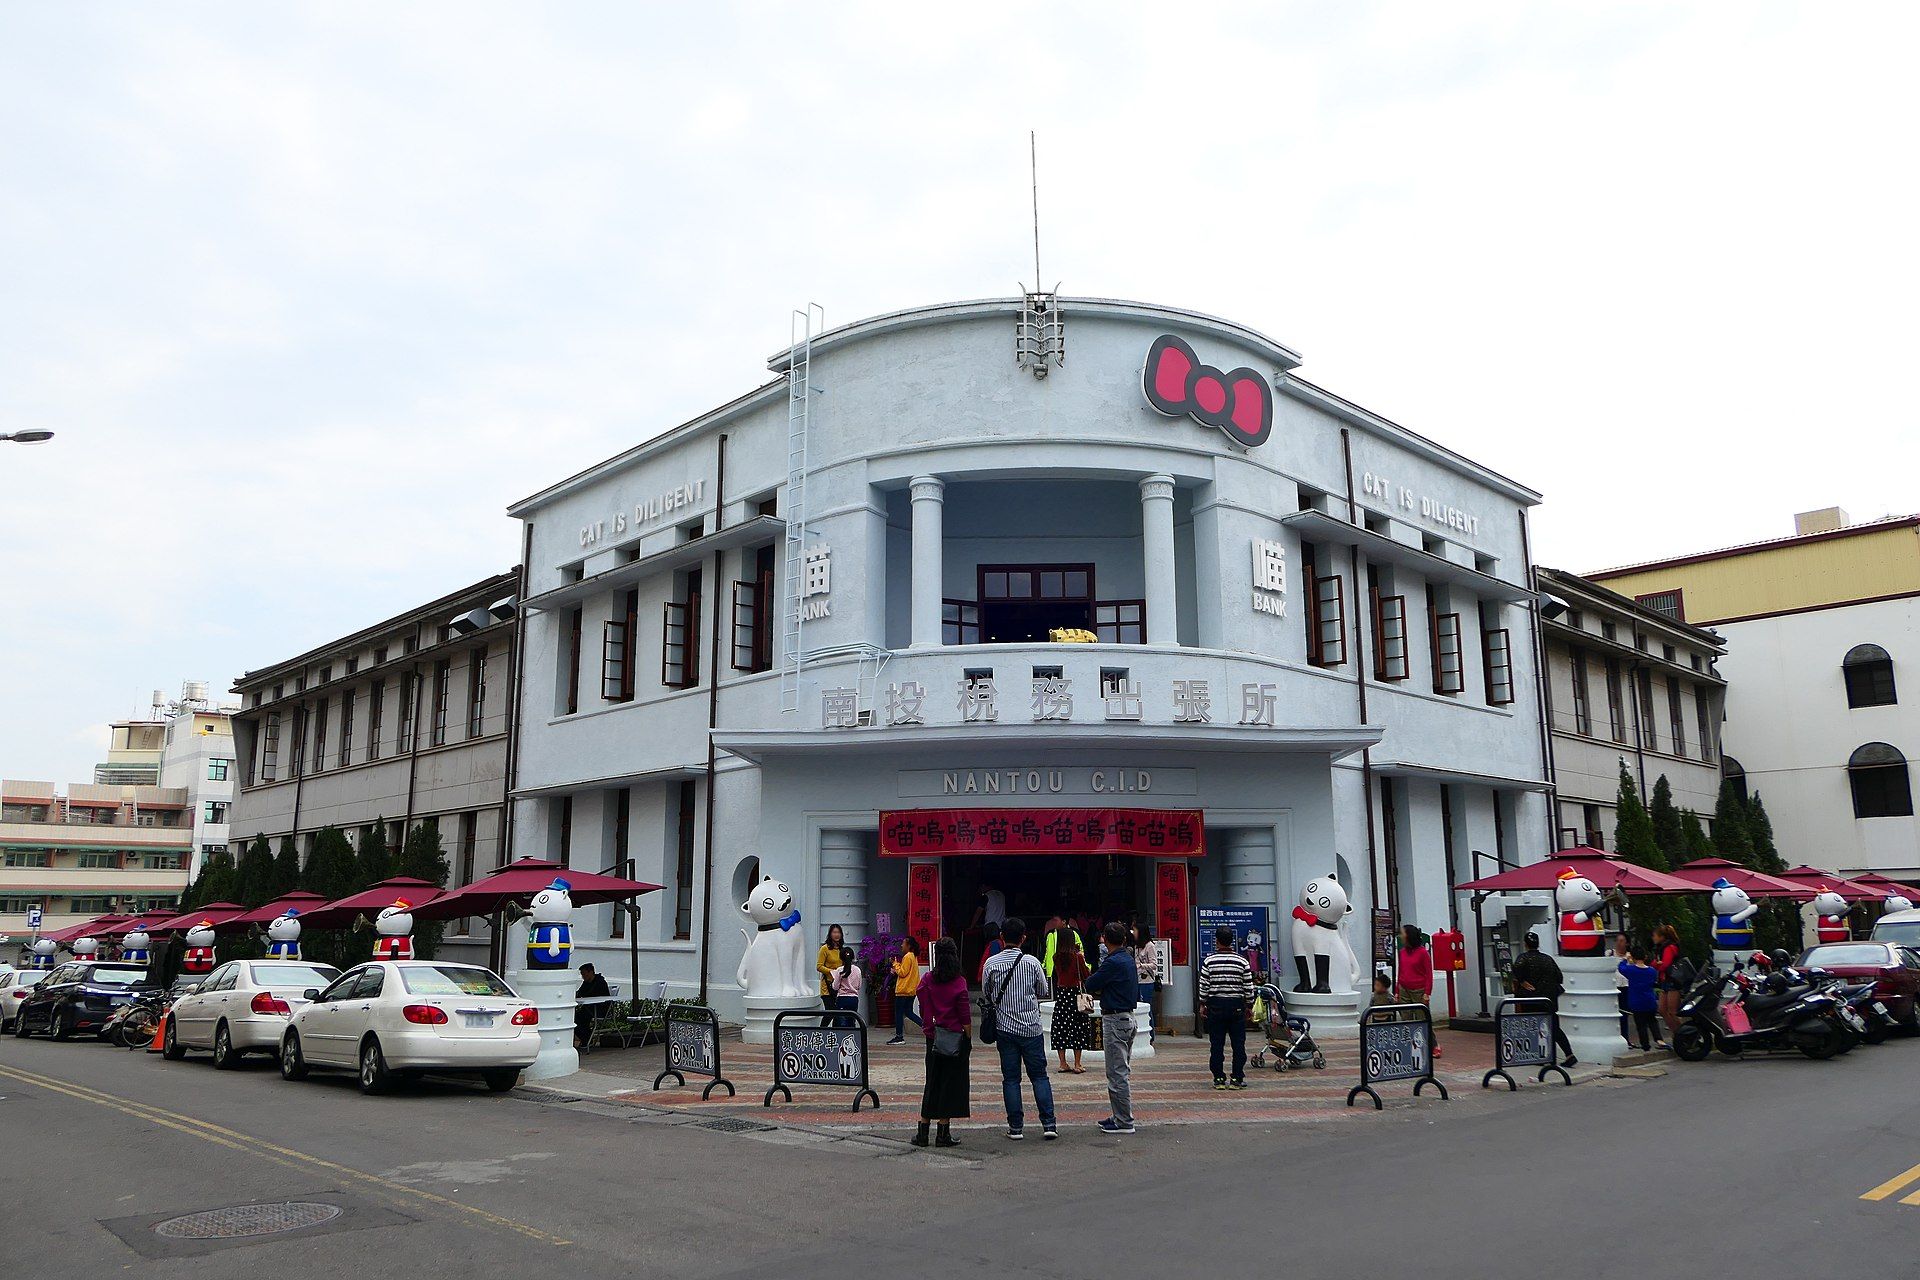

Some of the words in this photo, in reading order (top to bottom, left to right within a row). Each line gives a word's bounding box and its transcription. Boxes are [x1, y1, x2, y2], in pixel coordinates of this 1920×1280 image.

[579, 519, 603, 546] CAT
[611, 512, 626, 533] IS
[635, 479, 705, 524] DILIGENT
[1363, 471, 1389, 499] CAT
[1399, 486, 1414, 510] IS
[1421, 495, 1479, 536] DILIGENT
[1252, 536, 1287, 595] 喵
[795, 599, 831, 622] ANK
[1253, 592, 1288, 618] BANK
[821, 675, 1278, 728] 南投稅務出張所
[943, 770, 1063, 793] NANTOU
[1091, 770, 1152, 792] C.I.D
[682, 1043, 696, 1061] NO
[781, 1030, 839, 1052] 賣卵停車
[1515, 1037, 1531, 1055] NO
[801, 1053, 827, 1071] NO
[1382, 1048, 1402, 1067] NO
[801, 1070, 840, 1080] PARKING
